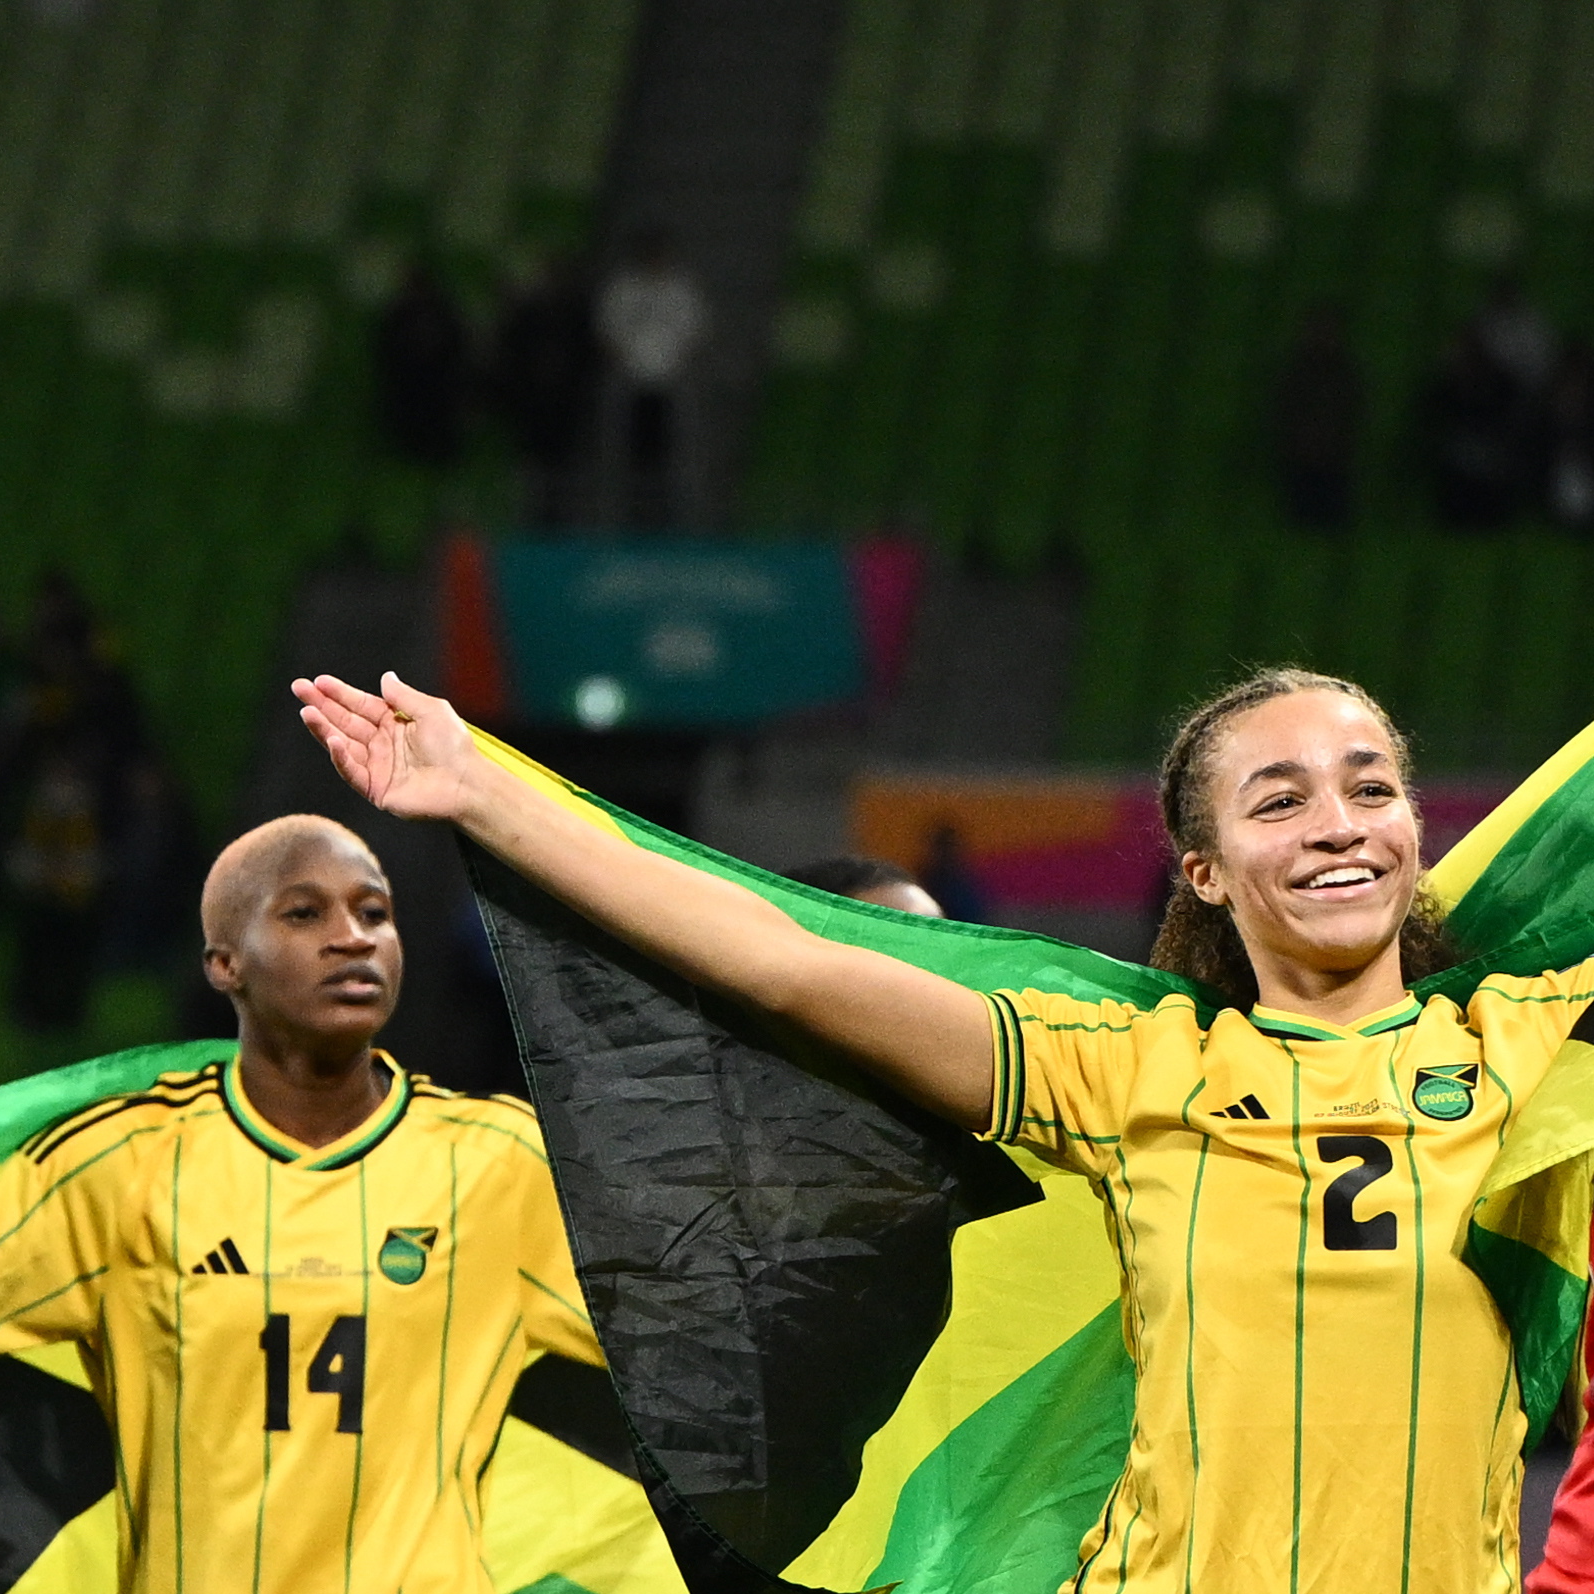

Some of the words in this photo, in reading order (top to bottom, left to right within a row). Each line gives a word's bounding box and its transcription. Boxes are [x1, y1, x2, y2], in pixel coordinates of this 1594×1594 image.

[1419, 1091, 1467, 1106] JAMAICA
[1316, 1135, 1397, 1251] 2
[259, 1314, 367, 1434] 14
